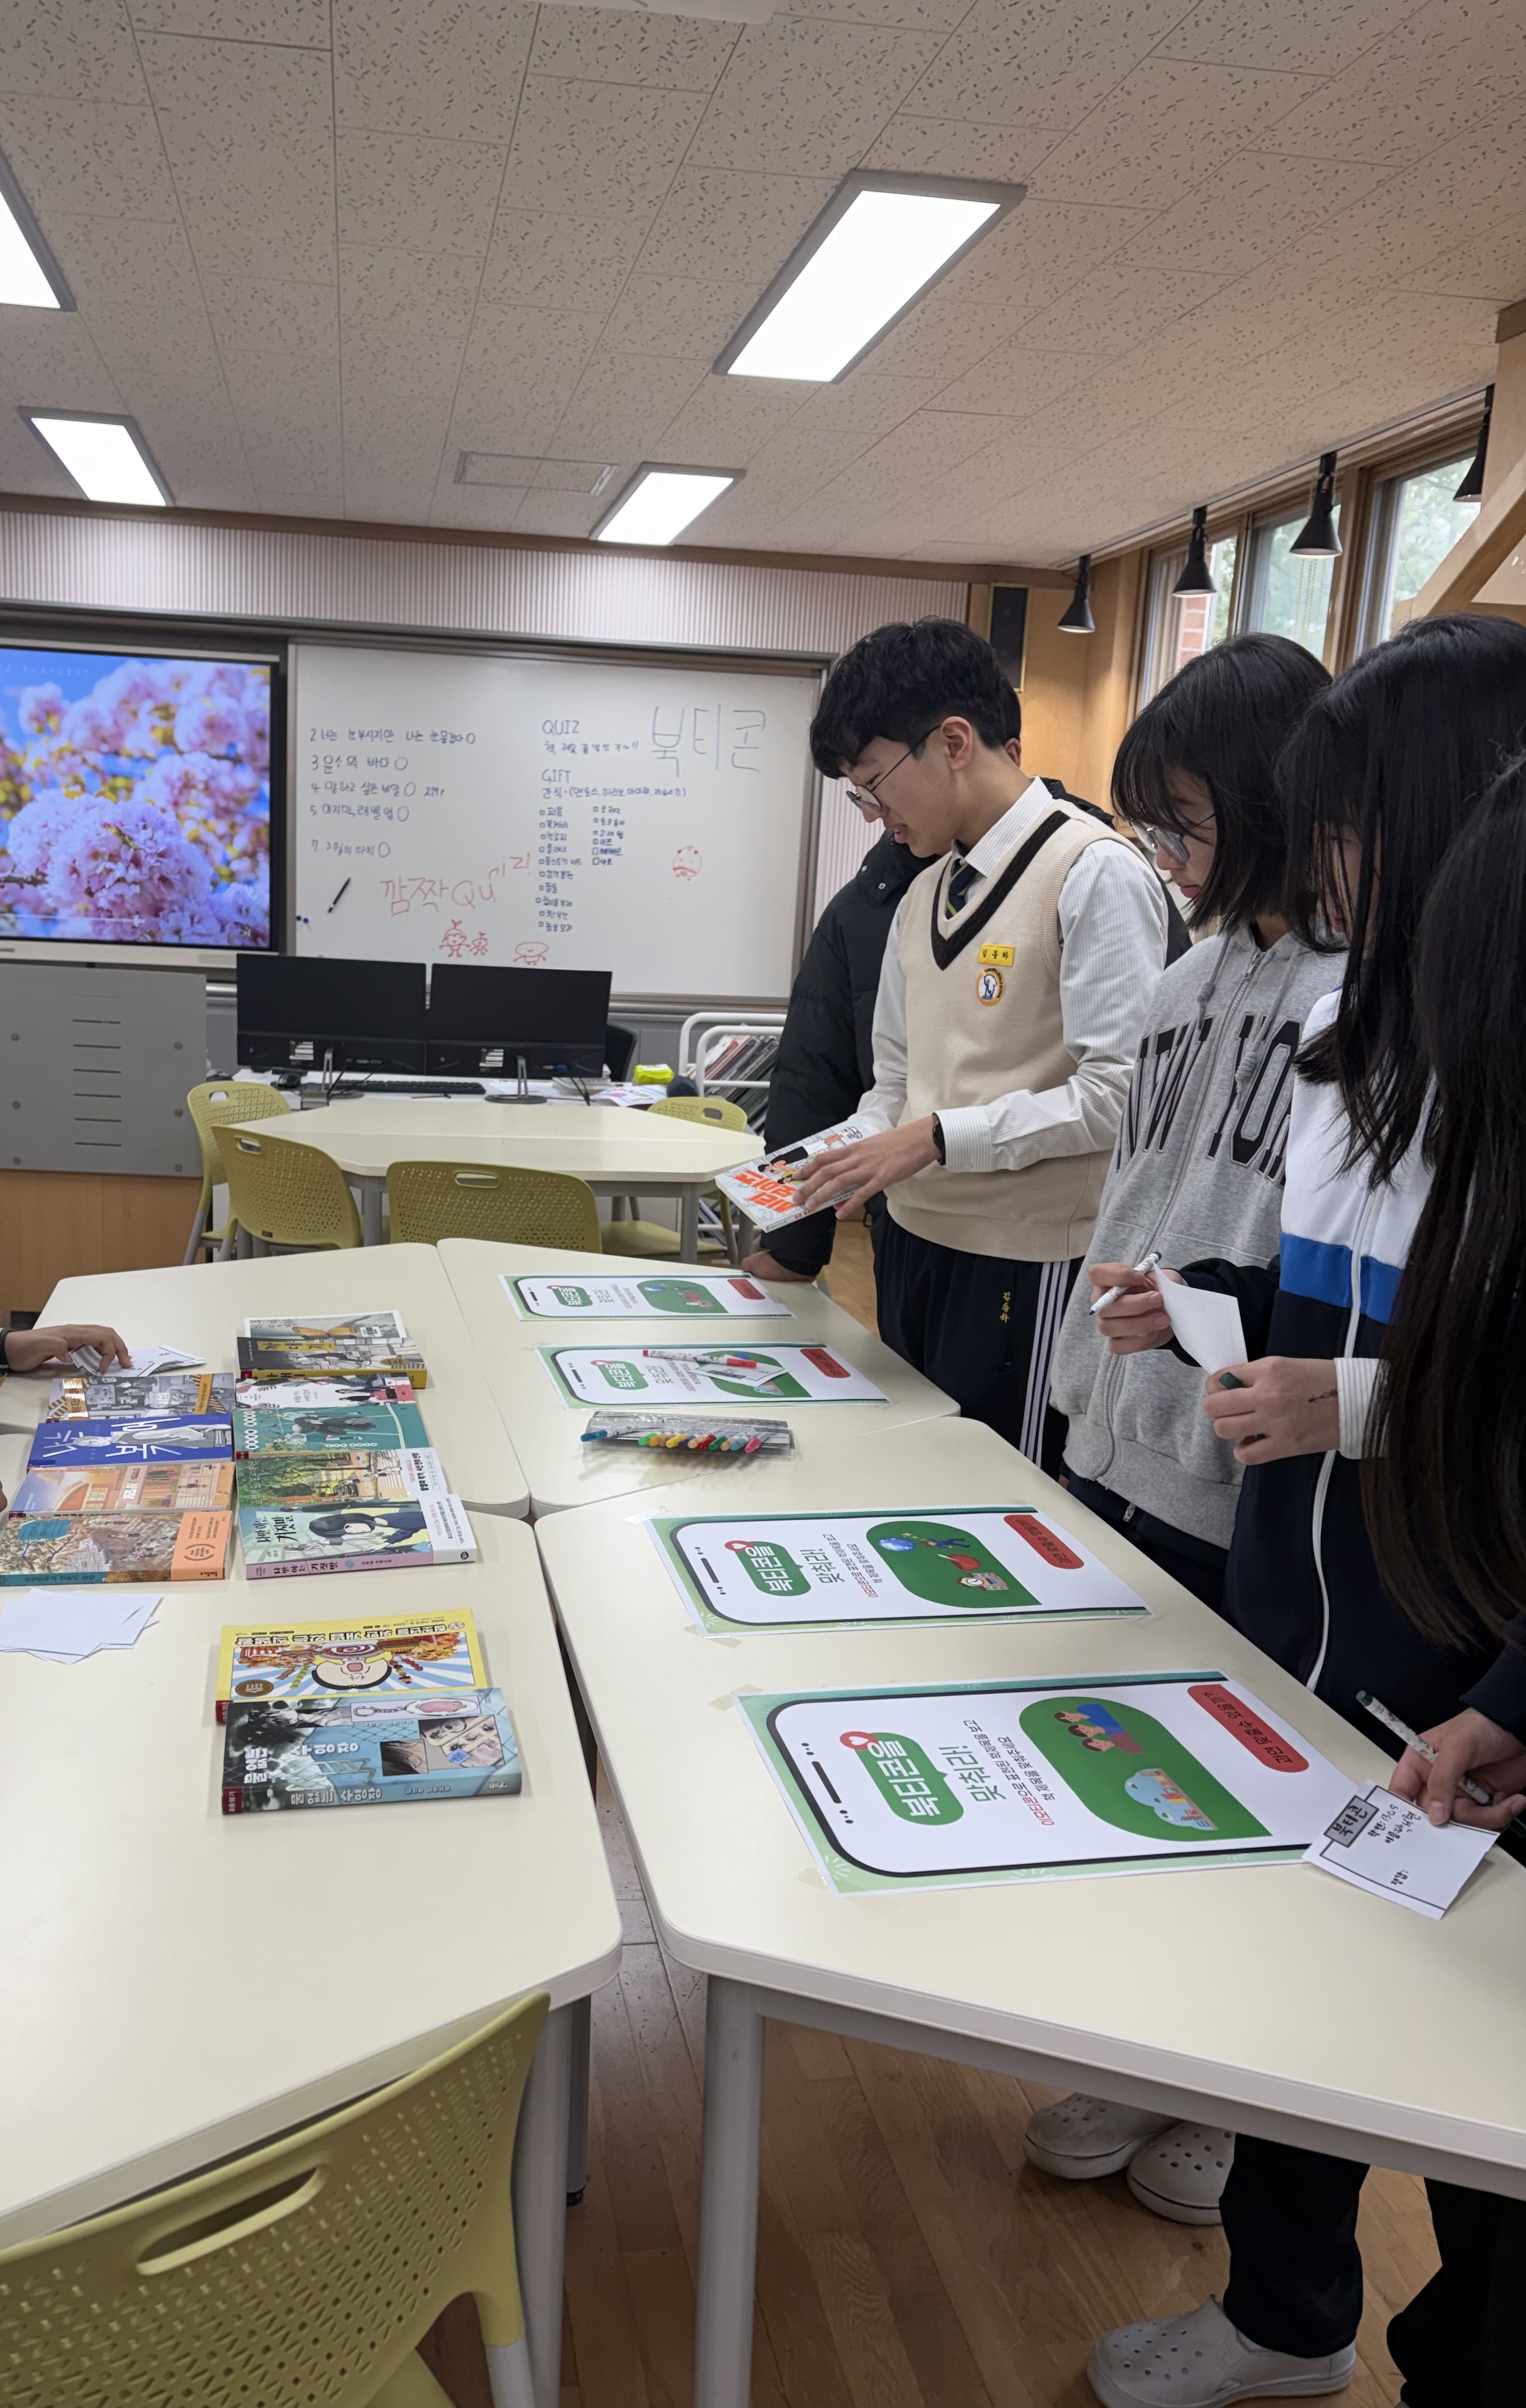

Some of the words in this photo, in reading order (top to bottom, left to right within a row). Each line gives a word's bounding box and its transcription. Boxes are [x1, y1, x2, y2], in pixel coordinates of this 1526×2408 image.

[406, 729, 424, 742] 나는
[542, 719, 579, 736] QUIZ
[652, 703, 766, 778] 북티콘
[366, 756, 390, 768] 바다
[541, 768, 572, 783] GIFT
[380, 876, 449, 917] 깜짝
[604, 1363, 638, 1387] 북티콘을
[252, 1517, 267, 1529] 아는
[270, 1514, 298, 1543] 거짓말
[254, 1529, 273, 1542] 나만
[311, 1560, 340, 1571] 거짓말
[743, 1545, 798, 1591] 북티콘을
[799, 1548, 845, 1583] 맞춰라!
[292, 1633, 325, 1643] 있는
[328, 1631, 362, 1641] 개념
[364, 1629, 392, 1638] 위한
[395, 1624, 448, 1635] 청소년을
[235, 1634, 288, 1647] 식생활
[1203, 1692, 1244, 1718] 있을까?
[963, 1719, 983, 1732] 보고
[289, 1741, 359, 1756] 수영장
[973, 1733, 1003, 1759] 책제목을
[996, 1736, 1033, 1768] 맞춰주세요
[1264, 1746, 1293, 1764] 과연
[244, 1747, 268, 1771] 없는
[244, 1771, 268, 1784] 물
[865, 1739, 941, 1816] 북티콘을
[938, 1745, 1006, 1801] 맞춰라!
[994, 1760, 1021, 1781] 표현된
[1024, 1770, 1051, 1792] 제목을
[290, 1793, 305, 1806] 물
[307, 1790, 335, 1805] 없는
[341, 1786, 382, 1802] 수영장
[1012, 1782, 1055, 1826] 이모티콘으로
[1333, 1805, 1368, 1837] 북티콘
